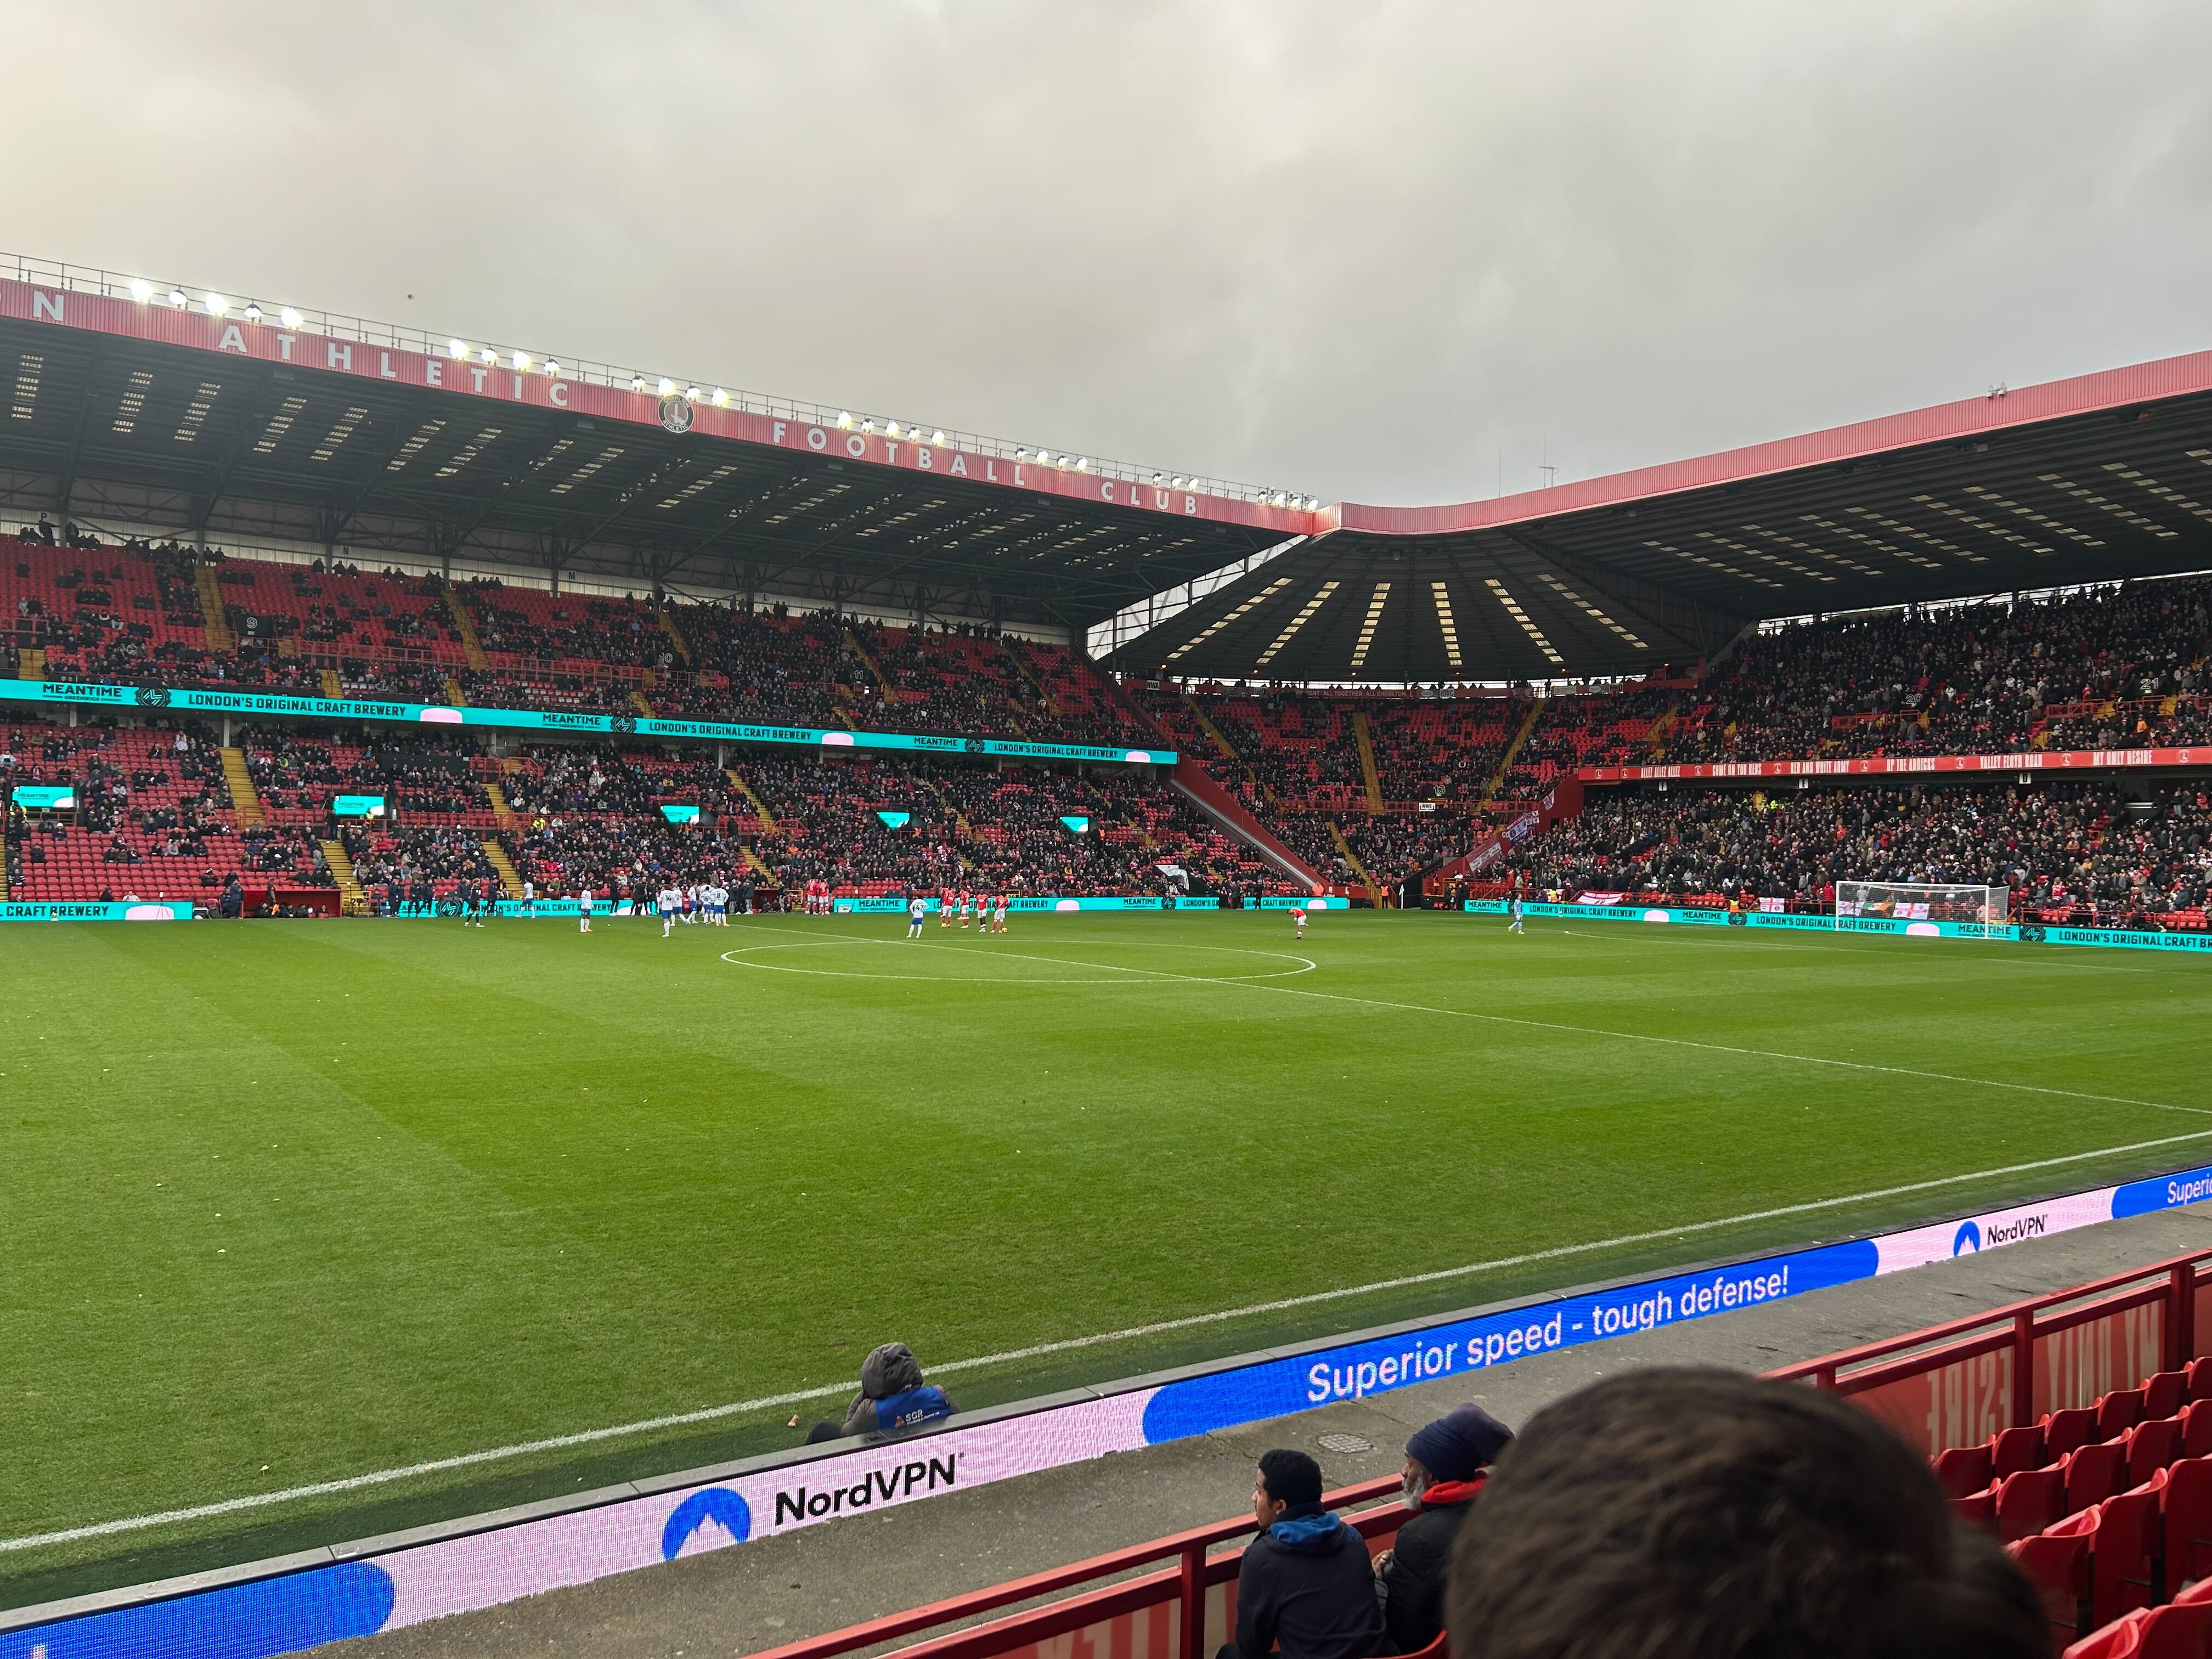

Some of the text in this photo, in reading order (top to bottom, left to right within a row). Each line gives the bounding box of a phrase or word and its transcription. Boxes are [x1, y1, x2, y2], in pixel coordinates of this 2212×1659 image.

[218, 325, 567, 406] ATHLETIC
[663, 394, 691, 408] CHARLTON
[662, 419, 689, 432] ATHLETIC
[774, 421, 1197, 515] FOOTBALL CLUB
[42, 683, 407, 716] MEANTIME LONDON'S ORIGINAL CRAFT BREWERY
[543, 714, 811, 740] MEANTIME LONDON'S ORIGINAL CRAFT BREWERY
[914, 737, 1118, 758] MEANTIME LONDON'S ORIGINAL CRAFT BREWERY
[1979, 754, 2042, 769] VALLEY FLOYD ROAD
[2093, 749, 2153, 765] MY ONLY DESIRE
[1815, 760, 1832, 774] WHITE
[7, 905, 109, 916] CRAFT BREWERY
[553, 904, 577, 912] CRAFT
[578, 904, 612, 912] BWERY
[1021, 900, 1048, 908] BREWERY
[1530, 905, 1559, 913] LONDON'S
[1560, 907, 1588, 915] ORIGINAL
[1589, 908, 1607, 916] CRAFT
[1609, 909, 1637, 918] BREWERY
[1682, 911, 1722, 919] MEANTIME
[1757, 916, 1794, 926] LONDON'S
[1795, 918, 1832, 928] ORIGINAL
[1859, 921, 1896, 930] BREWERY
[1958, 924, 2011, 934] MEANTIME
[2059, 930, 2111, 943] LONDON'S
[2112, 933, 2162, 946] ORIGINAL
[2164, 936, 2198, 948] CRAFT
[1987, 1214, 2045, 1246] NordVPN
[1308, 1341, 1458, 1402] Superior
[1466, 1312, 1562, 1366] speed
[1592, 1289, 1673, 1335] tough
[1679, 1266, 1789, 1317] defense!
[775, 1454, 956, 1526] NordVPN
